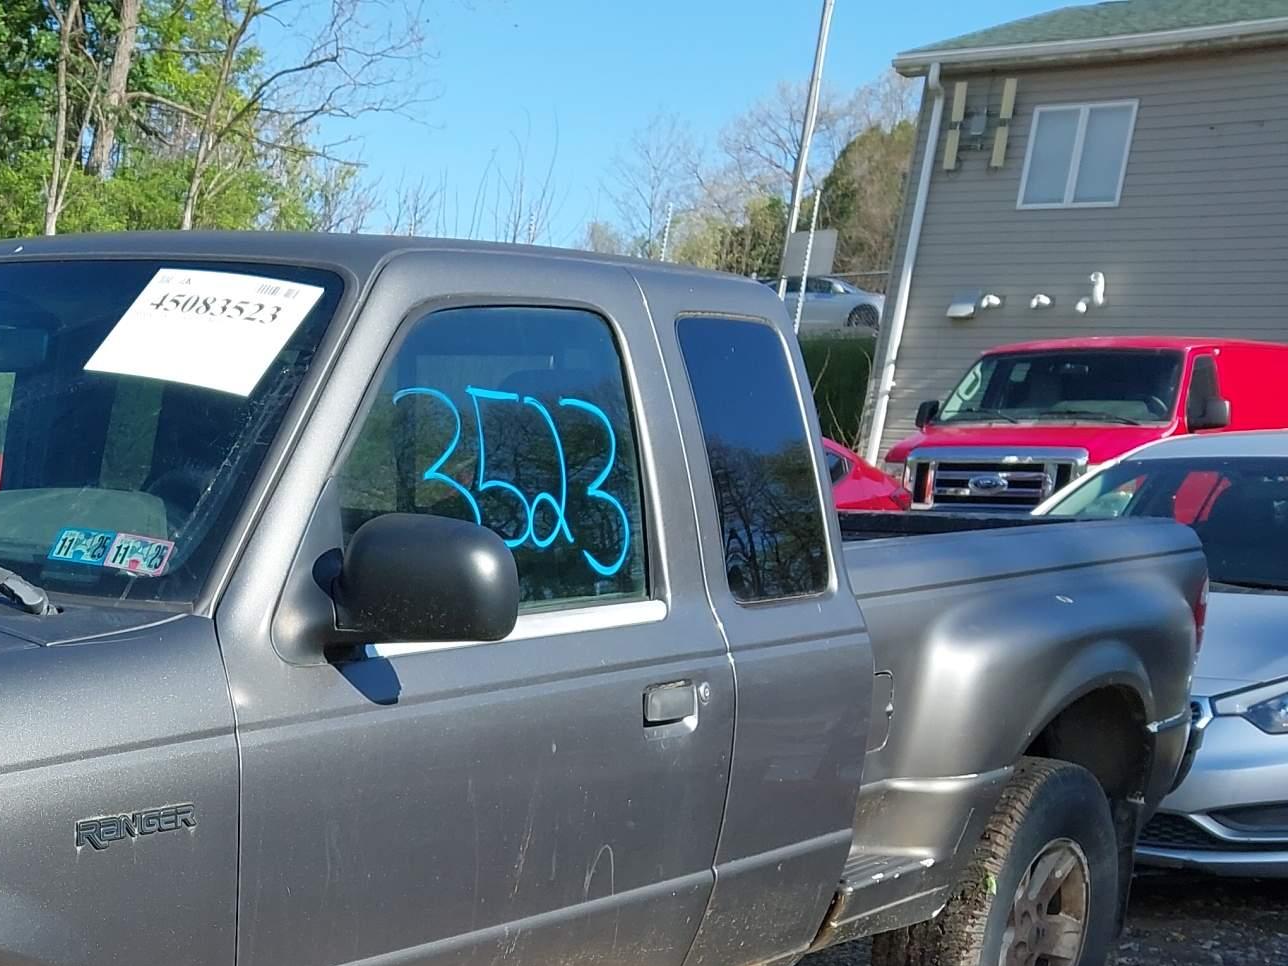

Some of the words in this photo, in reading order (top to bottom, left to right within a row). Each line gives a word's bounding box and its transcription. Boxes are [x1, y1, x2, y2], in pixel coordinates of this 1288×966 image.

[149, 291, 283, 325] 45083523
[55, 536, 75, 556] 11
[91, 535, 111, 559] 25
[111, 543, 131, 565] 11
[147, 544, 169, 569] 25
[75, 802, 199, 851] RANGER
